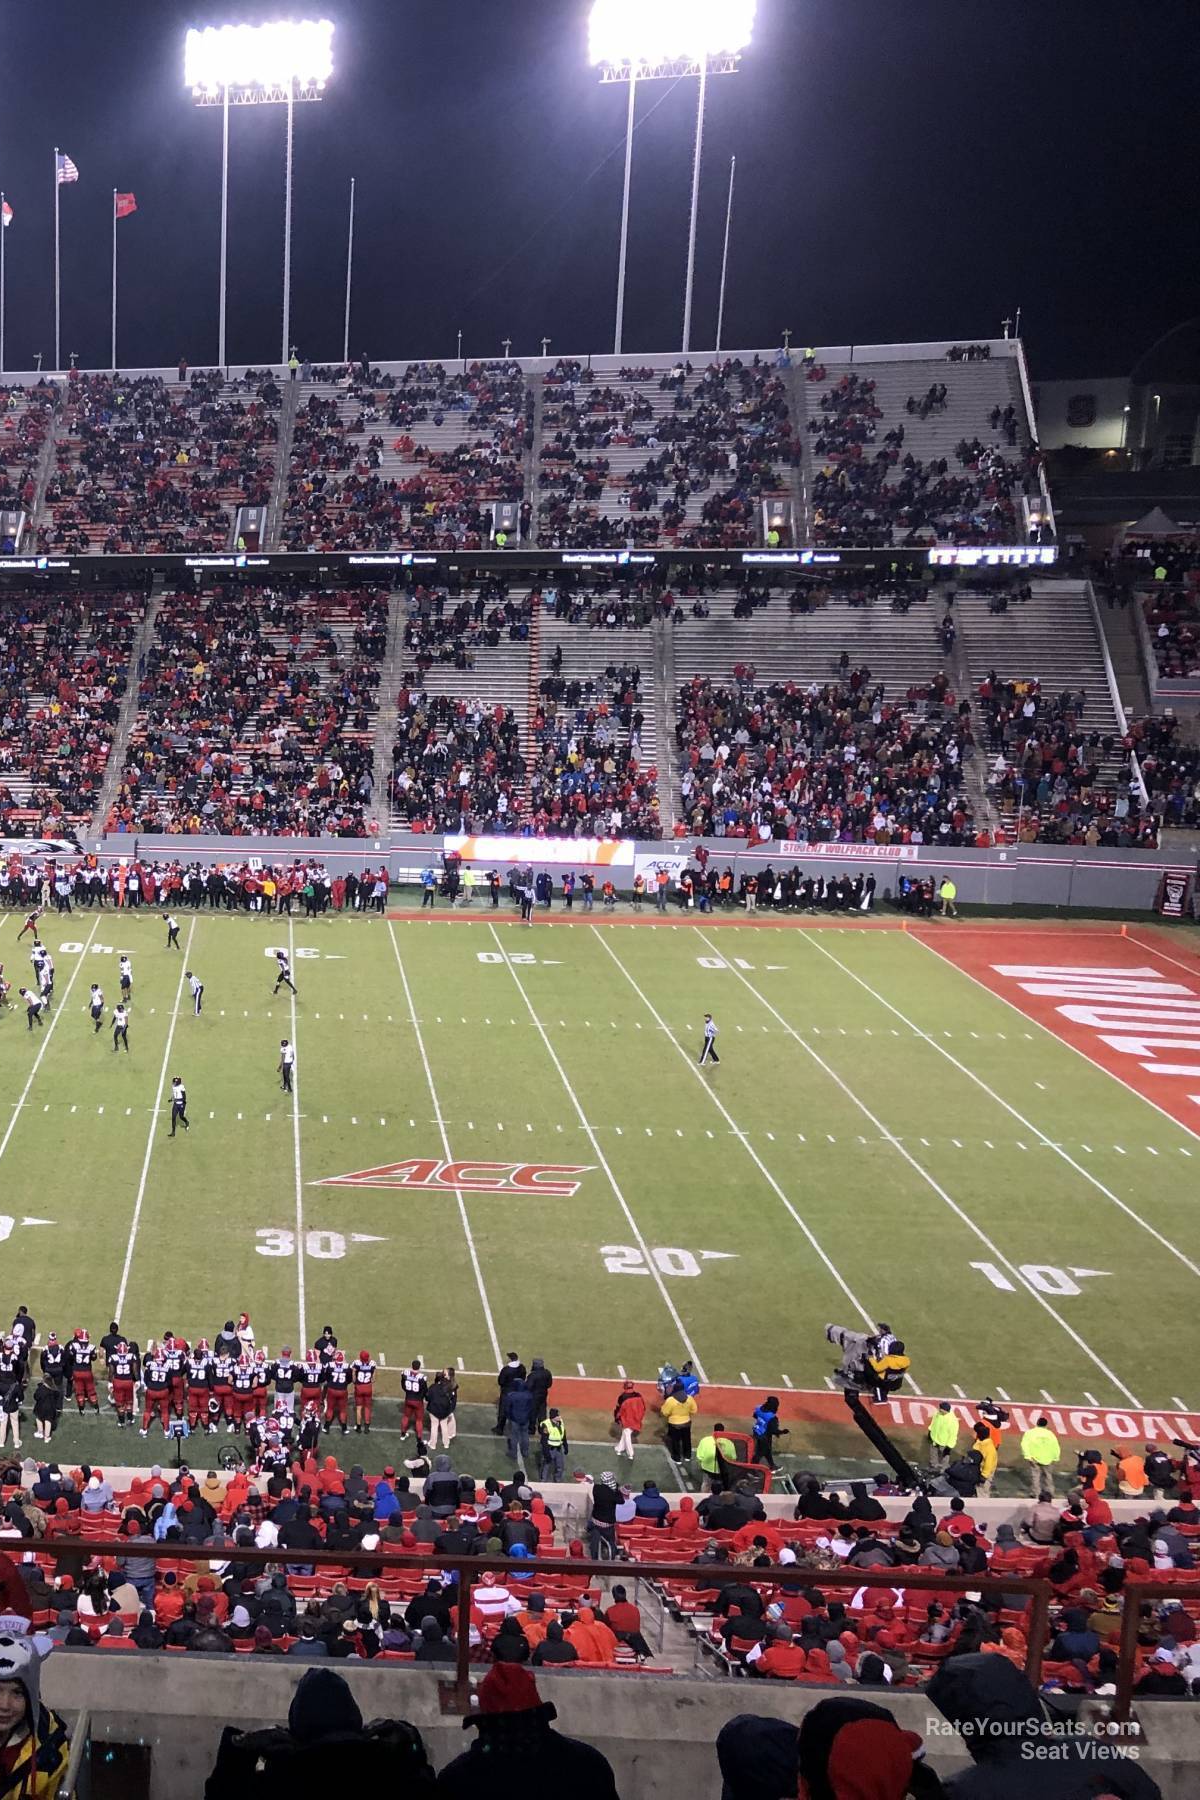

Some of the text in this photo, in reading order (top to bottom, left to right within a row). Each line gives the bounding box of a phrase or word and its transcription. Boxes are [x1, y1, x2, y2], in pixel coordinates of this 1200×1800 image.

[674, 845, 680, 853] 7
[825, 844, 875, 856] WOLFPACK
[877, 845, 900, 857] CLUB
[646, 861, 681, 869] ACCN
[58, 942, 114, 954] 40
[264, 946, 320, 959] 30
[476, 951, 537, 965] 20
[696, 957, 756, 969] 10
[318, 1159, 598, 1192] ACC
[255, 1228, 347, 1260] 30
[599, 1244, 702, 1278] 20
[968, 1261, 1083, 1297] 10
[47, 1353, 61, 1364] 34
[76, 1353, 90, 1364] 54
[332, 1372, 346, 1383] 75
